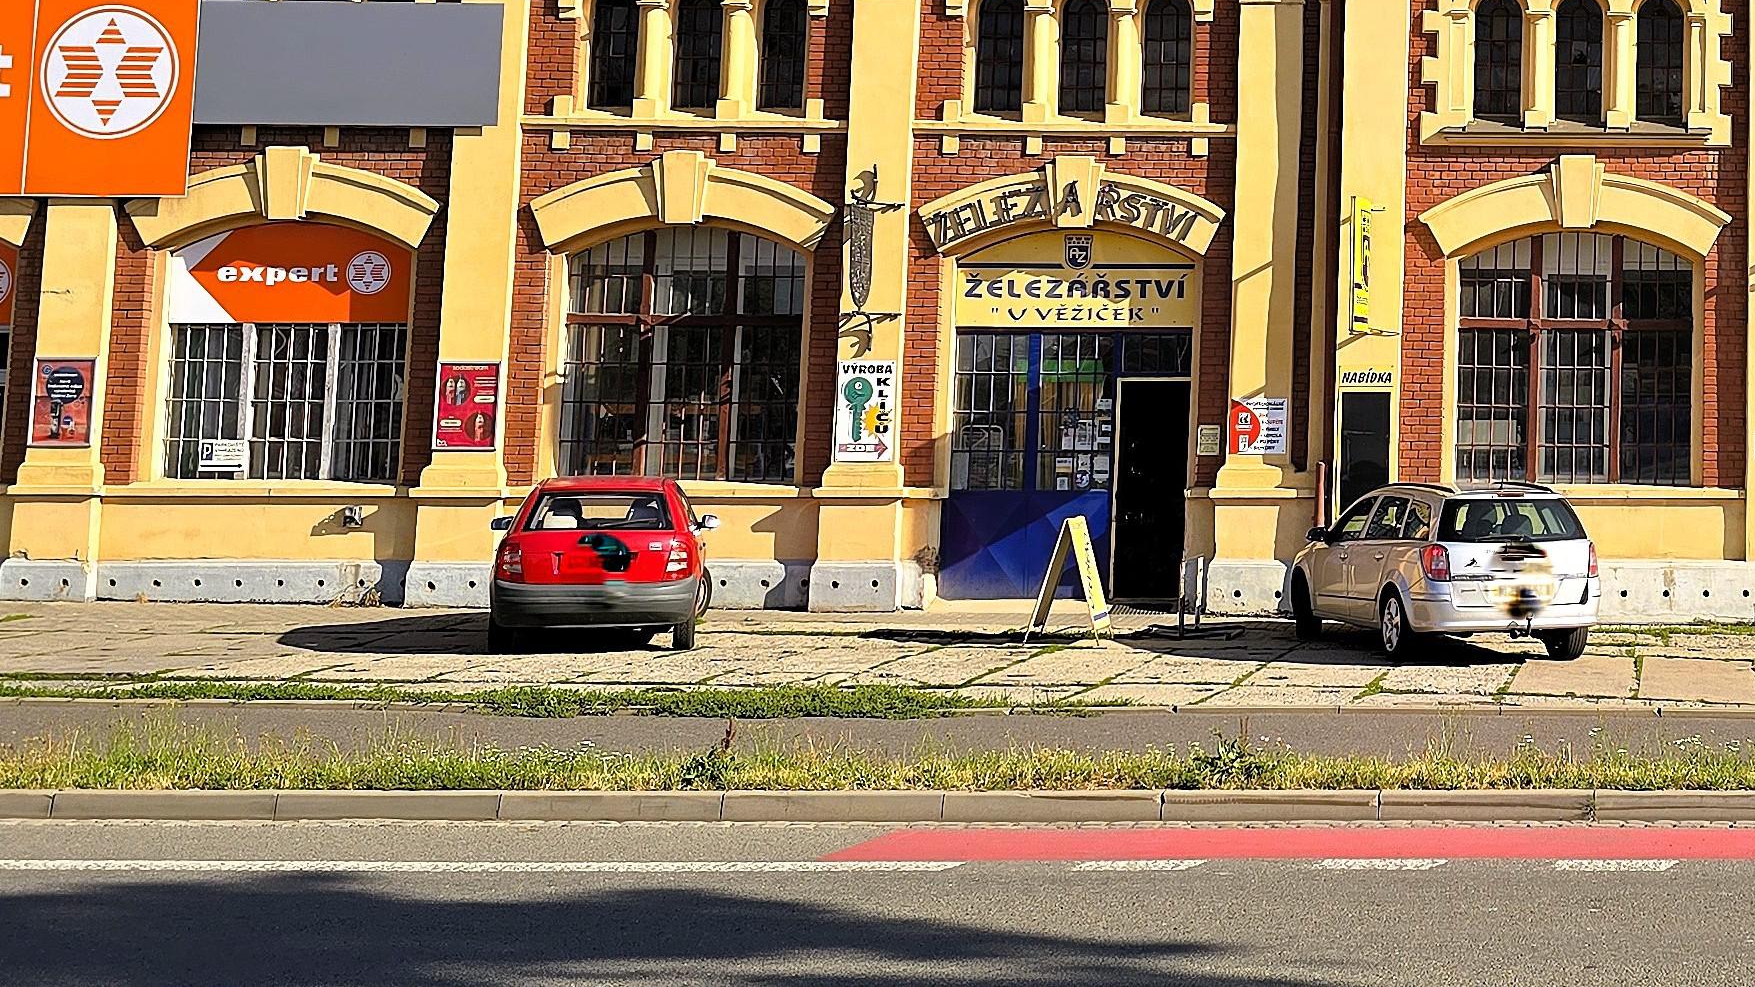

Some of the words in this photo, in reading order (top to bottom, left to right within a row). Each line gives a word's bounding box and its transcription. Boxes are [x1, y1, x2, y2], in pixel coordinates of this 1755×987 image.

[216, 264, 339, 286] expert
[964, 272, 1189, 299] ŽELEZÁŘSTVÍ
[1034, 303, 1145, 321] VĚŽIČEK
[842, 362, 893, 374] VÝROBA
[1341, 367, 1393, 384] NABÍDKA
